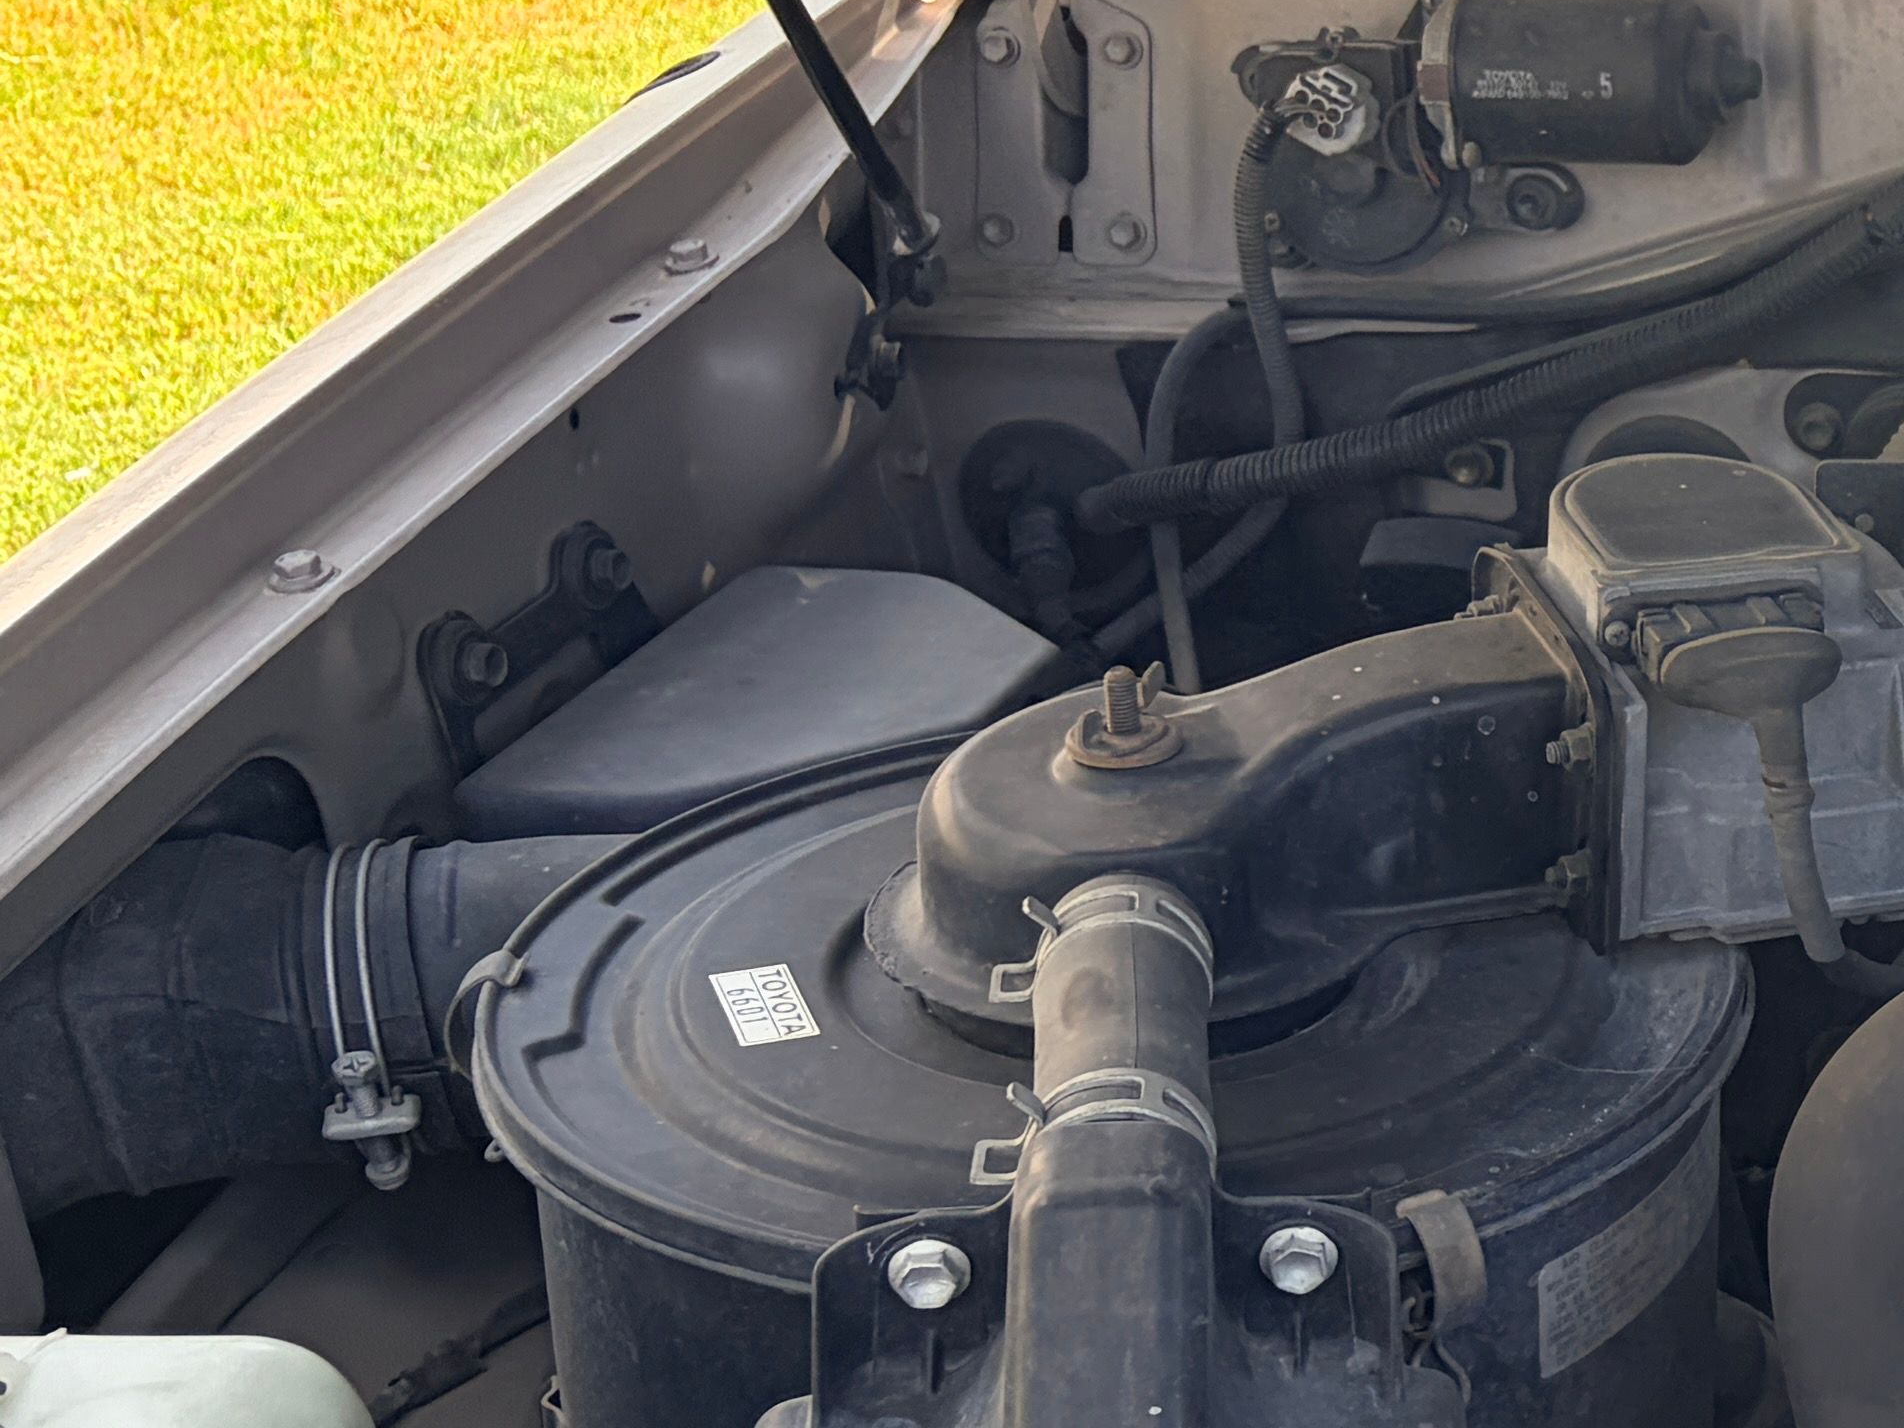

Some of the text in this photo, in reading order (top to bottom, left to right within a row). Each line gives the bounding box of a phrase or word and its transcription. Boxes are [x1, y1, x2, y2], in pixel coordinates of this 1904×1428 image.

[1600, 72, 1613, 100] 5
[727, 988, 769, 1023] 6601
[758, 969, 806, 1035] TOYOTA
